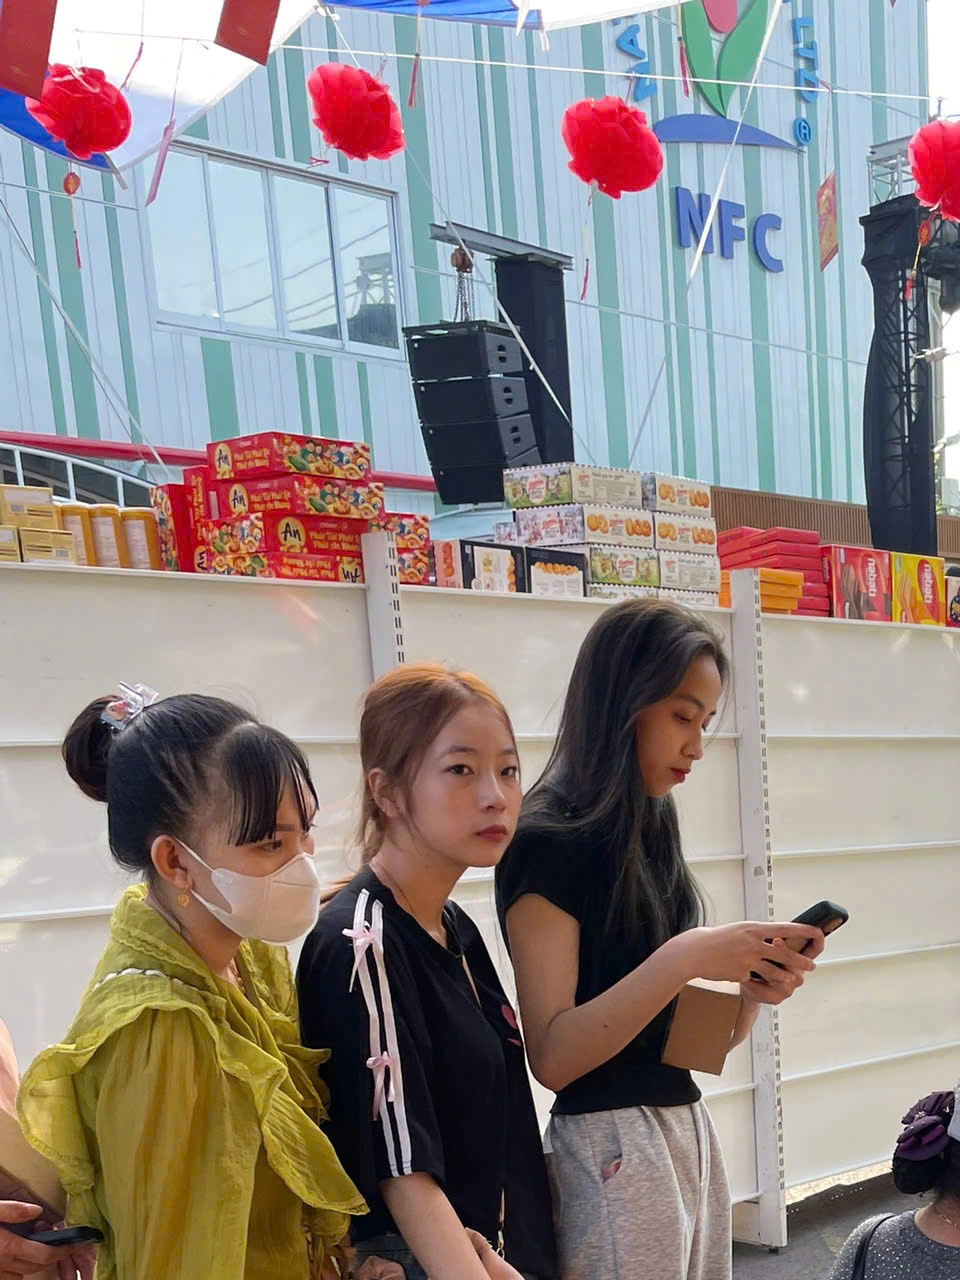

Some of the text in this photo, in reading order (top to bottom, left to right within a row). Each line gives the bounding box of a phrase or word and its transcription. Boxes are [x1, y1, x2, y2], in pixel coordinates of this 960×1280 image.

[674, 186, 784, 273] NFC
[281, 521, 302, 542] An
[867, 557, 876, 598] nabati
[924, 563, 934, 604] nabati
